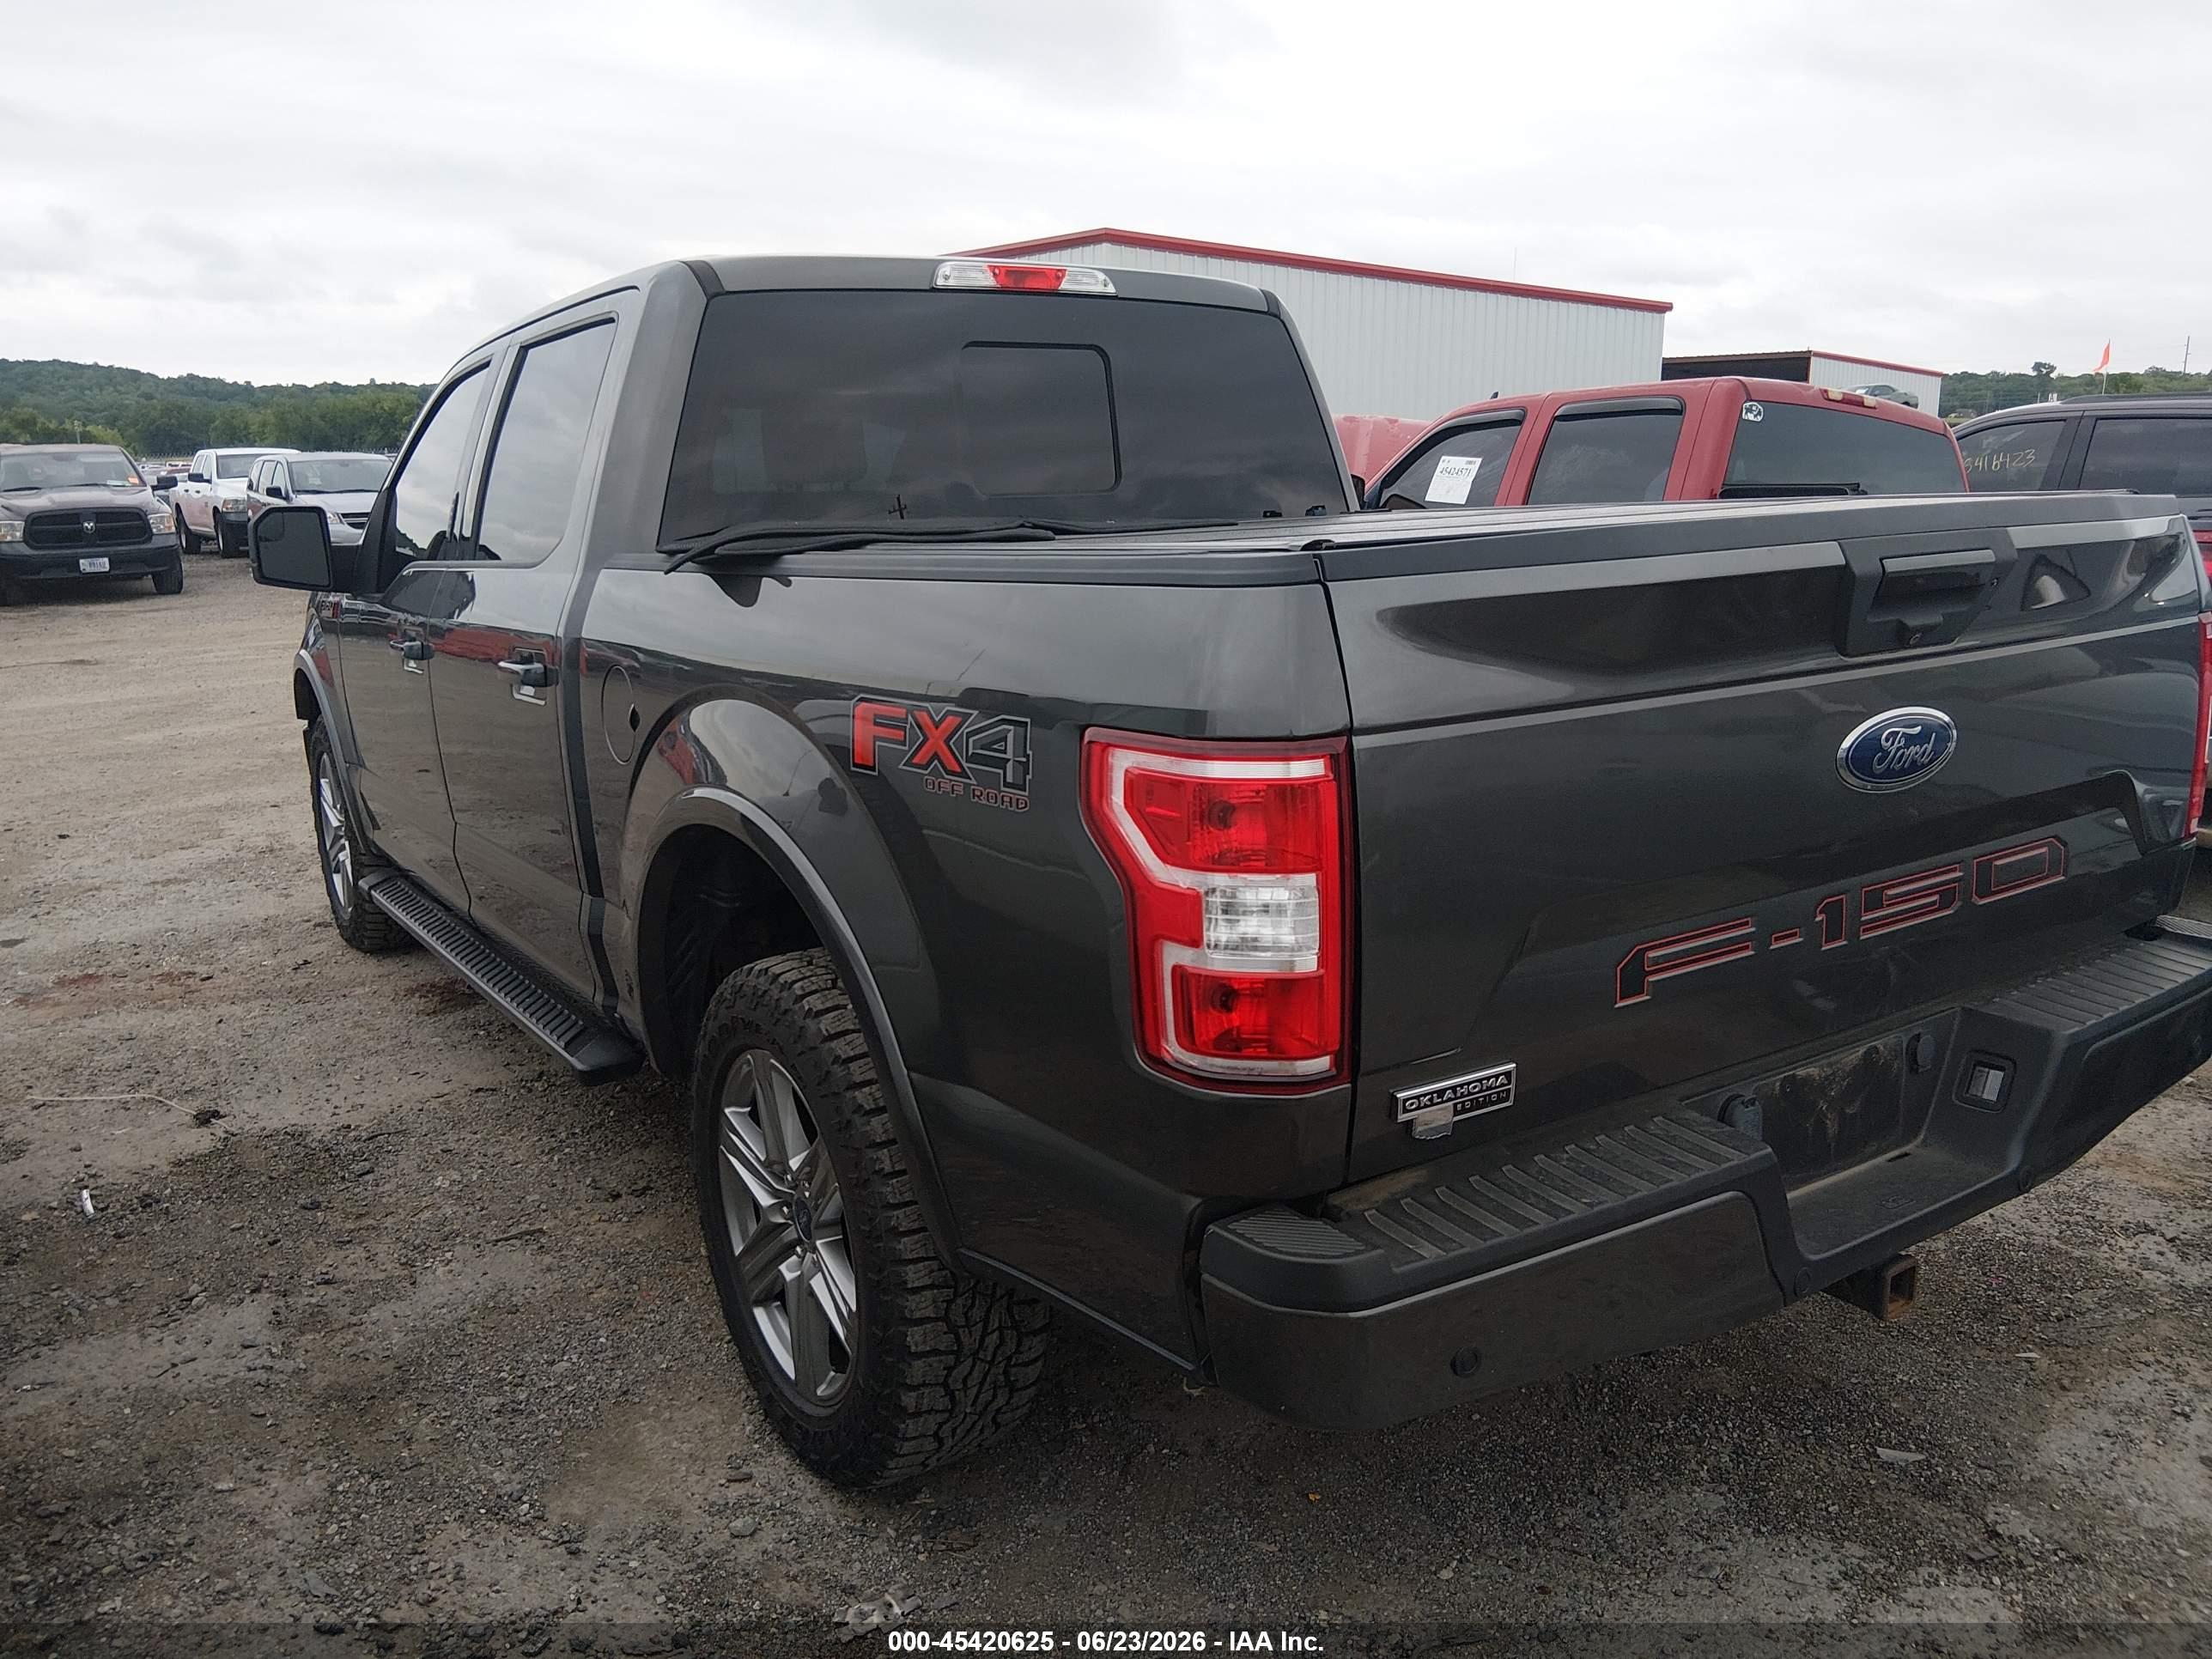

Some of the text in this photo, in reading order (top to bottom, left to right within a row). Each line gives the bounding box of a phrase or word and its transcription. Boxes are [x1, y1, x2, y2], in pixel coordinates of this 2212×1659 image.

[850, 693, 1032, 795] FX4
[1873, 725, 1936, 774] Ford
[923, 776, 1030, 812] OFF ROAD
[1614, 836, 2066, 1008] F-150
[1405, 1074, 1509, 1110] OKLAHOMA
[1456, 1091, 1507, 1112] EDITION
